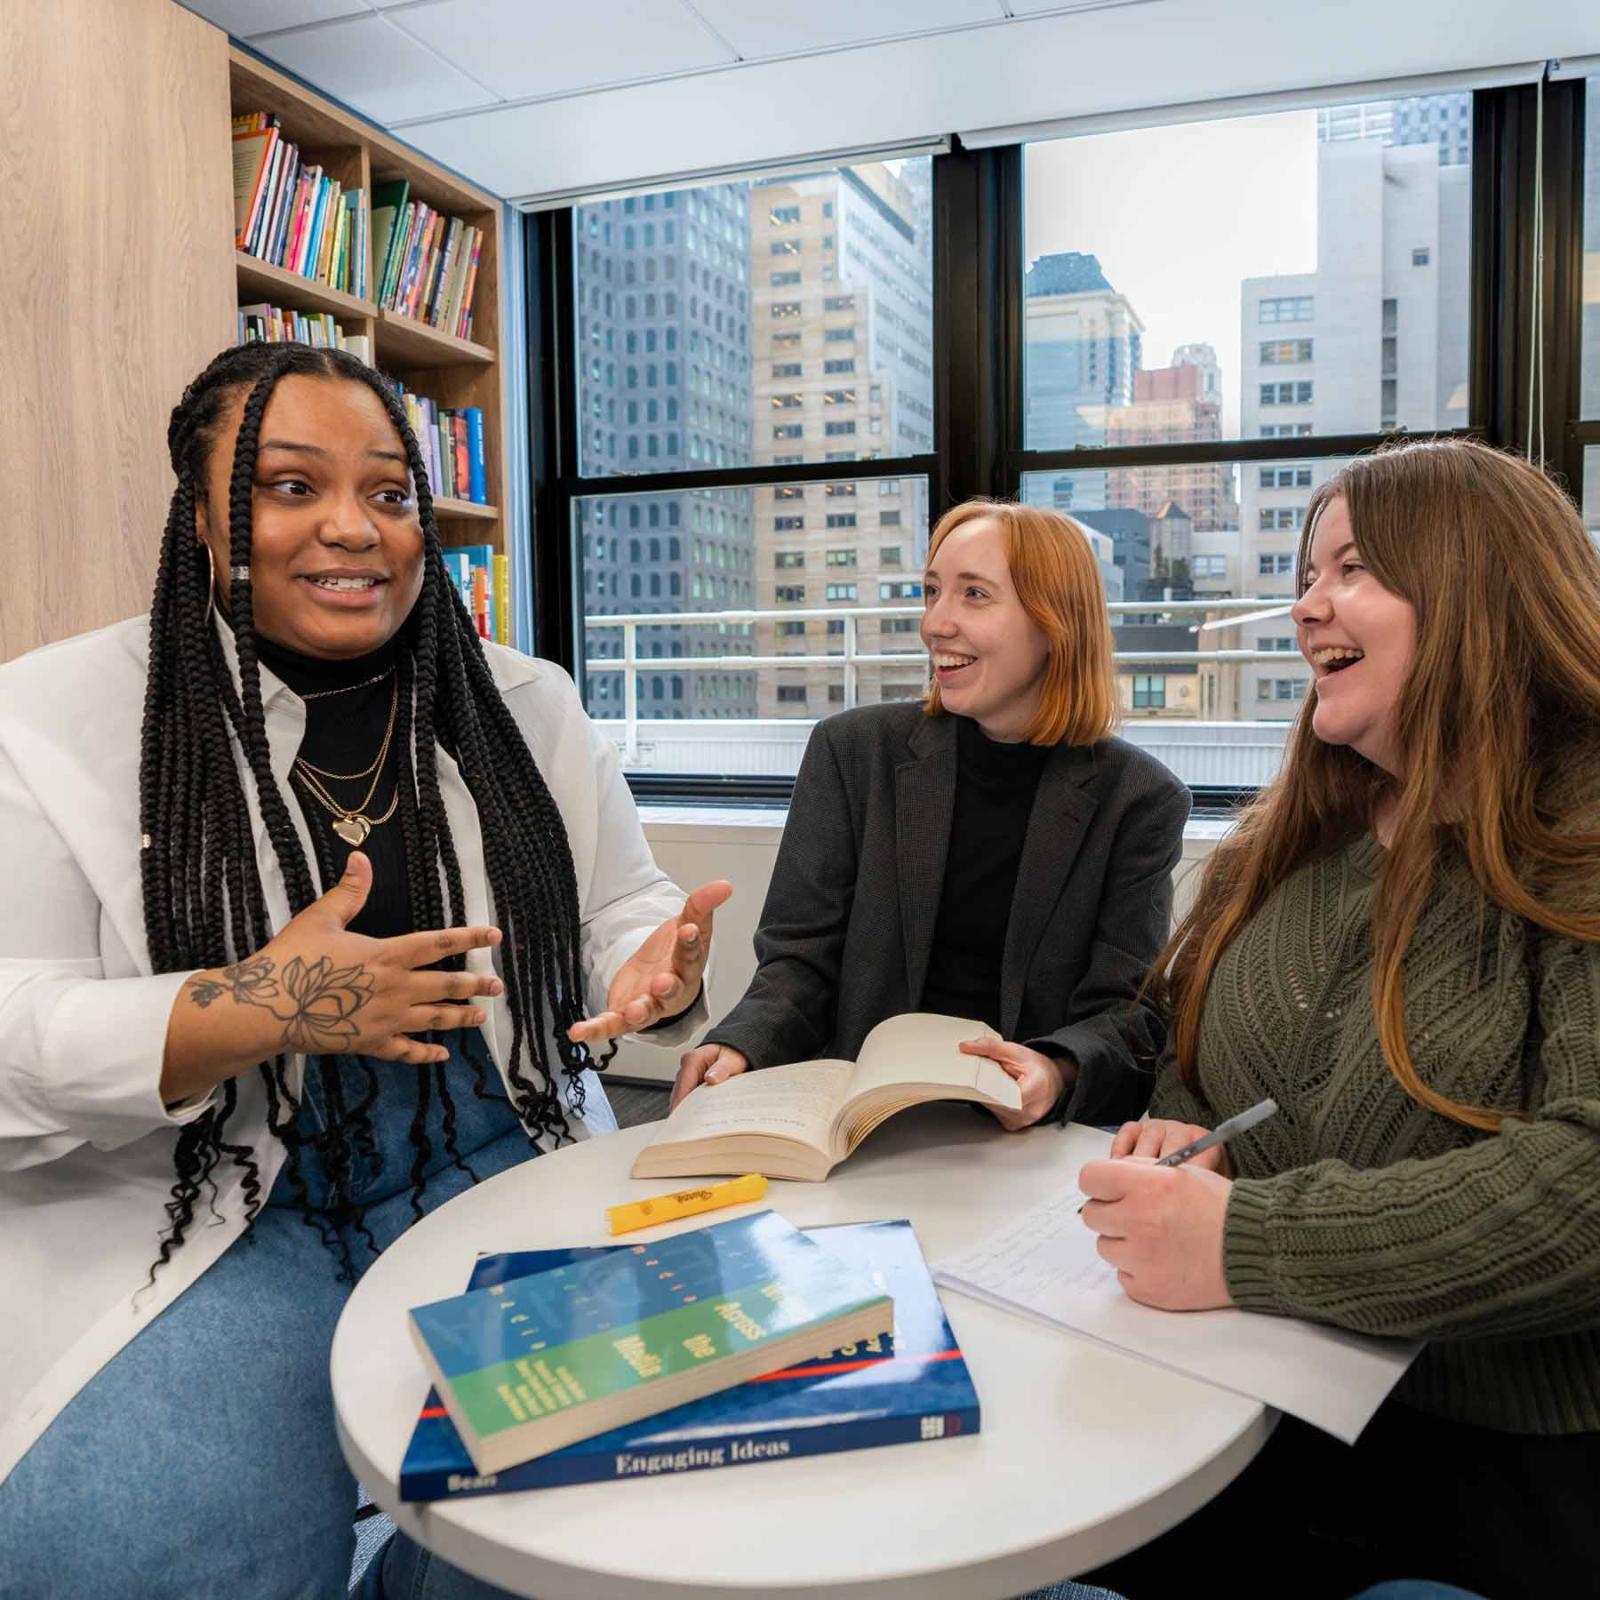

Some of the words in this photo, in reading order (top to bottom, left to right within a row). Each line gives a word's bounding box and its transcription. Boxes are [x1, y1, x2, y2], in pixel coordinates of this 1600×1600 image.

[714, 1302, 768, 1341] Across
[613, 1335, 662, 1378] Media
[682, 1333, 716, 1359] the
[615, 1447, 725, 1474] Engaging
[731, 1440, 791, 1461] Ideas
